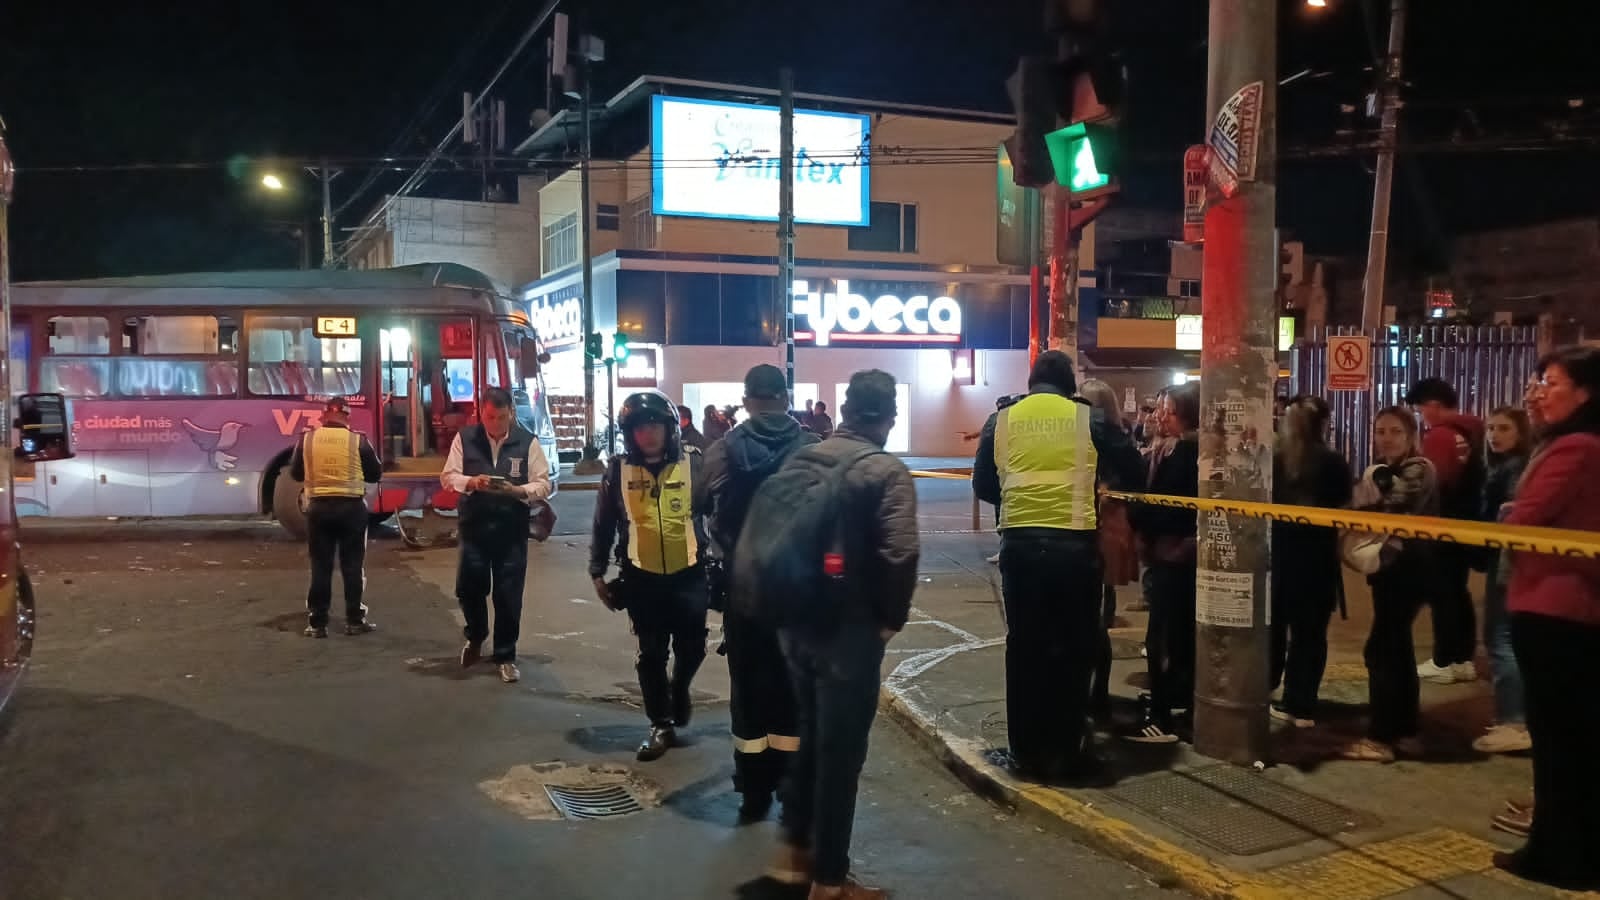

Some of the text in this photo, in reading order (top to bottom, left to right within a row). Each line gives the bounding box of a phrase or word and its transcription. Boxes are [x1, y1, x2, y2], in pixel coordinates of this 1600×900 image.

[787, 280, 962, 346] Fybeca
[84, 415, 141, 429] ciudad
[143, 416, 173, 428] más
[119, 429, 181, 443] mundo
